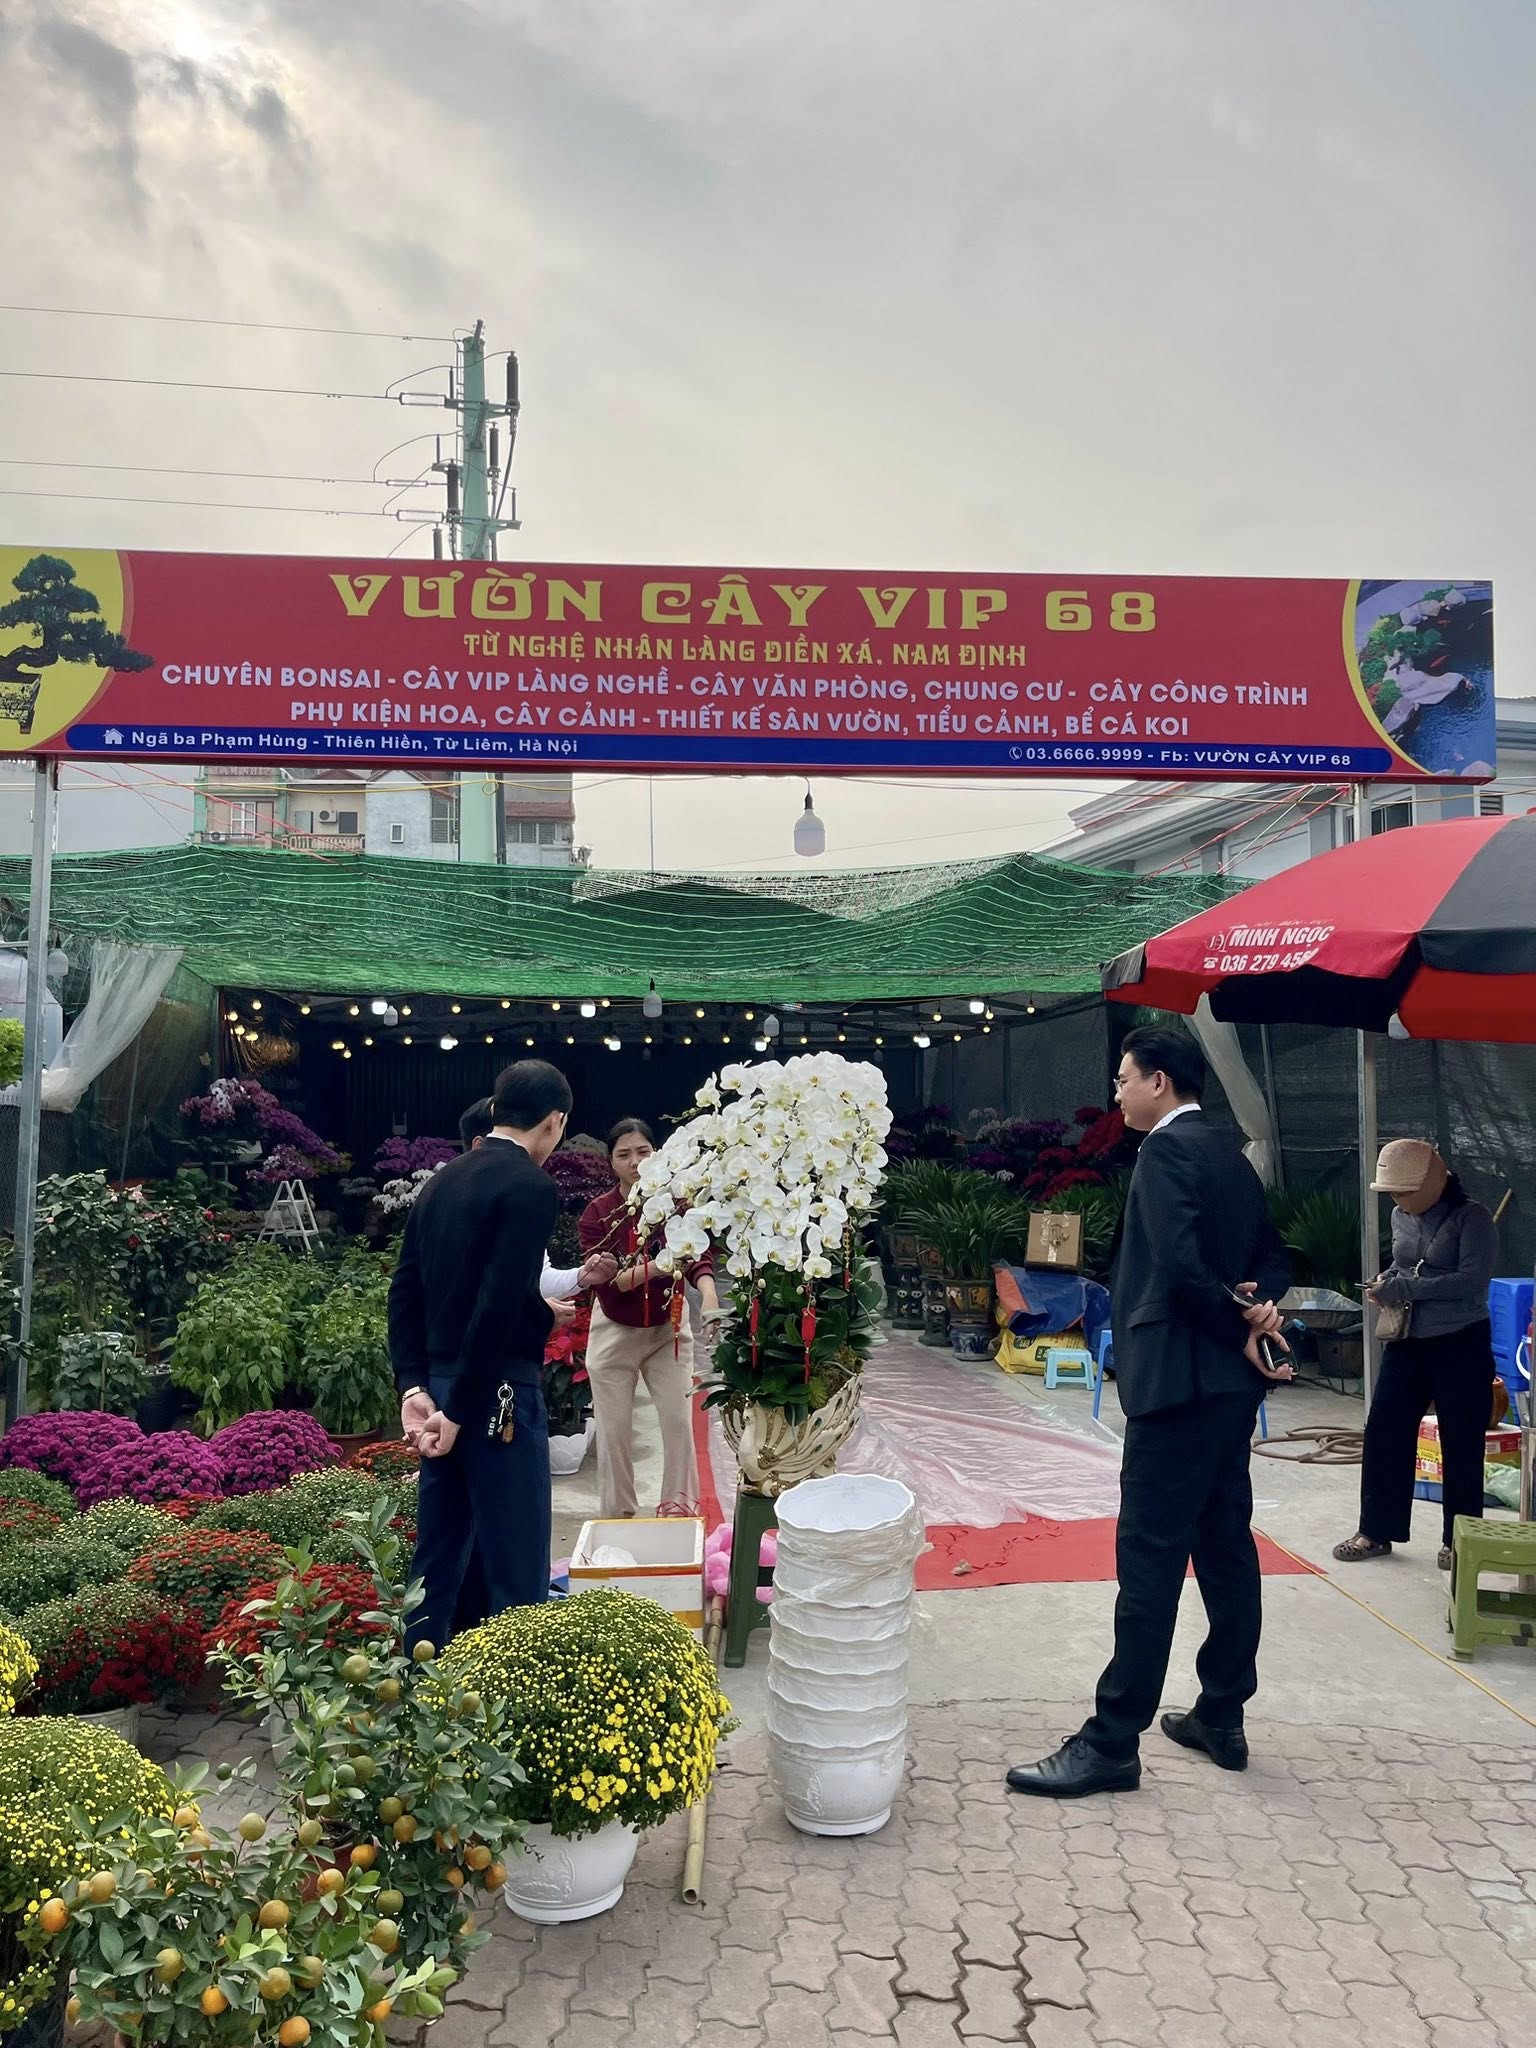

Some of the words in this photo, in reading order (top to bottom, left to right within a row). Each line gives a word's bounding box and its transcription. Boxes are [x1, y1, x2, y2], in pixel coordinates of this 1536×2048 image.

[328, 567, 603, 622] VƯỜN
[641, 573, 828, 627] CÂY
[856, 586, 1008, 630] VIP
[1045, 590, 1156, 632] 68
[463, 629, 501, 657] TỪ
[508, 631, 585, 663] NGHỆ
[594, 633, 673, 660] NHÂN
[682, 634, 755, 663] LÀNG
[763, 632, 828, 665] ĐIỀN
[892, 643, 951, 666] NAM
[958, 644, 1026, 671] ĐỊNH
[161, 660, 272, 687] CHUYÊN
[280, 667, 381, 689] BONSAI
[403, 665, 460, 691] CÂY
[466, 671, 510, 692] VIP
[518, 667, 589, 693] LÀNG
[597, 665, 669, 695] NGHỀ
[690, 671, 745, 696] CÂY
[752, 673, 806, 698] VĂN
[814, 674, 916, 703] PHÒNG,
[924, 680, 1019, 701] CHUNG
[1089, 678, 1143, 702] CÂY
[1149, 679, 1228, 704] CÔNG
[1234, 680, 1307, 706] TRÌNH
[291, 701, 343, 728] PHỤ
[352, 698, 411, 728] KIỆN
[419, 704, 487, 729] HOA,
[494, 701, 551, 728] CÂY
[558, 701, 635, 728] CẢNH
[657, 702, 725, 730] THIẾT
[731, 703, 764, 731] KẾ
[768, 707, 819, 732] SÂN
[826, 708, 909, 736] VƯỜN,
[915, 704, 967, 734] TIỂU
[974, 708, 1057, 738] CẢNH,
[1065, 706, 1094, 736] BỂ
[1100, 711, 1138, 736] CÁ
[1145, 716, 1188, 736] KOI
[132, 731, 168, 748] Ngã
[173, 732, 196, 745] ba
[201, 732, 253, 749] Phạm
[258, 733, 307, 750] Hùng
[323, 734, 375, 750] Thiên
[381, 734, 428, 752] Hiền,
[433, 736, 459, 751] Từ
[463, 737, 514, 754] Liêm,
[519, 739, 542, 752] Hà
[547, 739, 578, 755] Nội
[1025, 746, 1143, 761] 03.6666.9999
[1160, 750, 1189, 762] Fb:
[1193, 749, 1249, 763] VƯỜN
[1255, 751, 1292, 764] CÂY
[1296, 753, 1327, 765] VIP
[1330, 754, 1351, 766] 68
[1228, 927, 1281, 947] MINH
[1279, 925, 1336, 948] NGỌC
[1219, 954, 1249, 972] 036
[1248, 953, 1281, 972] 279
